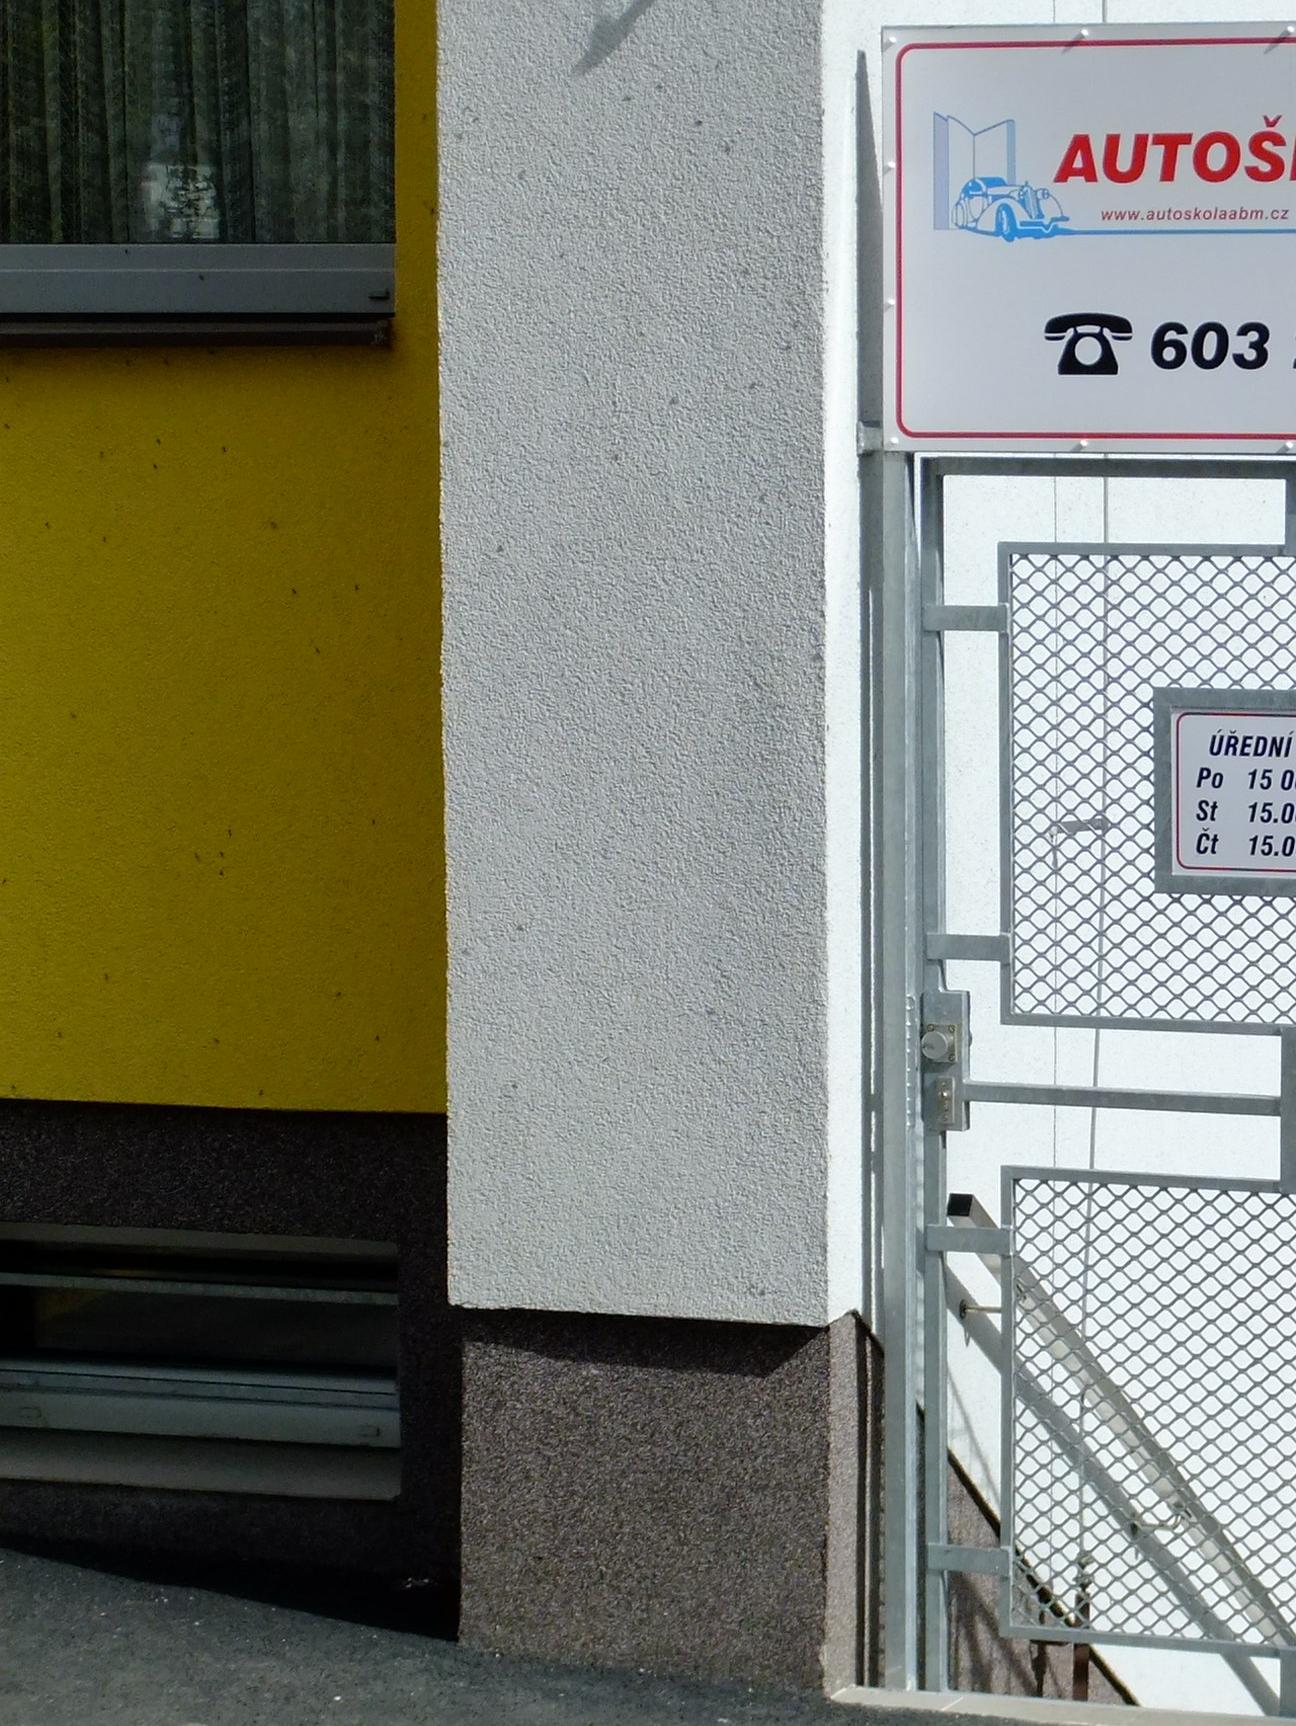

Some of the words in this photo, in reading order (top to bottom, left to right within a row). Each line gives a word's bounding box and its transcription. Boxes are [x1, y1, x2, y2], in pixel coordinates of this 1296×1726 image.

[1101, 206, 1290, 221] www.autoskolaabm.cz
[1150, 321, 1271, 370] 603
[1209, 728, 1294, 758] ÚŘEDNÍ
[1196, 767, 1224, 789] Po
[1195, 799, 1219, 822] St
[1195, 827, 1219, 855] Čt
